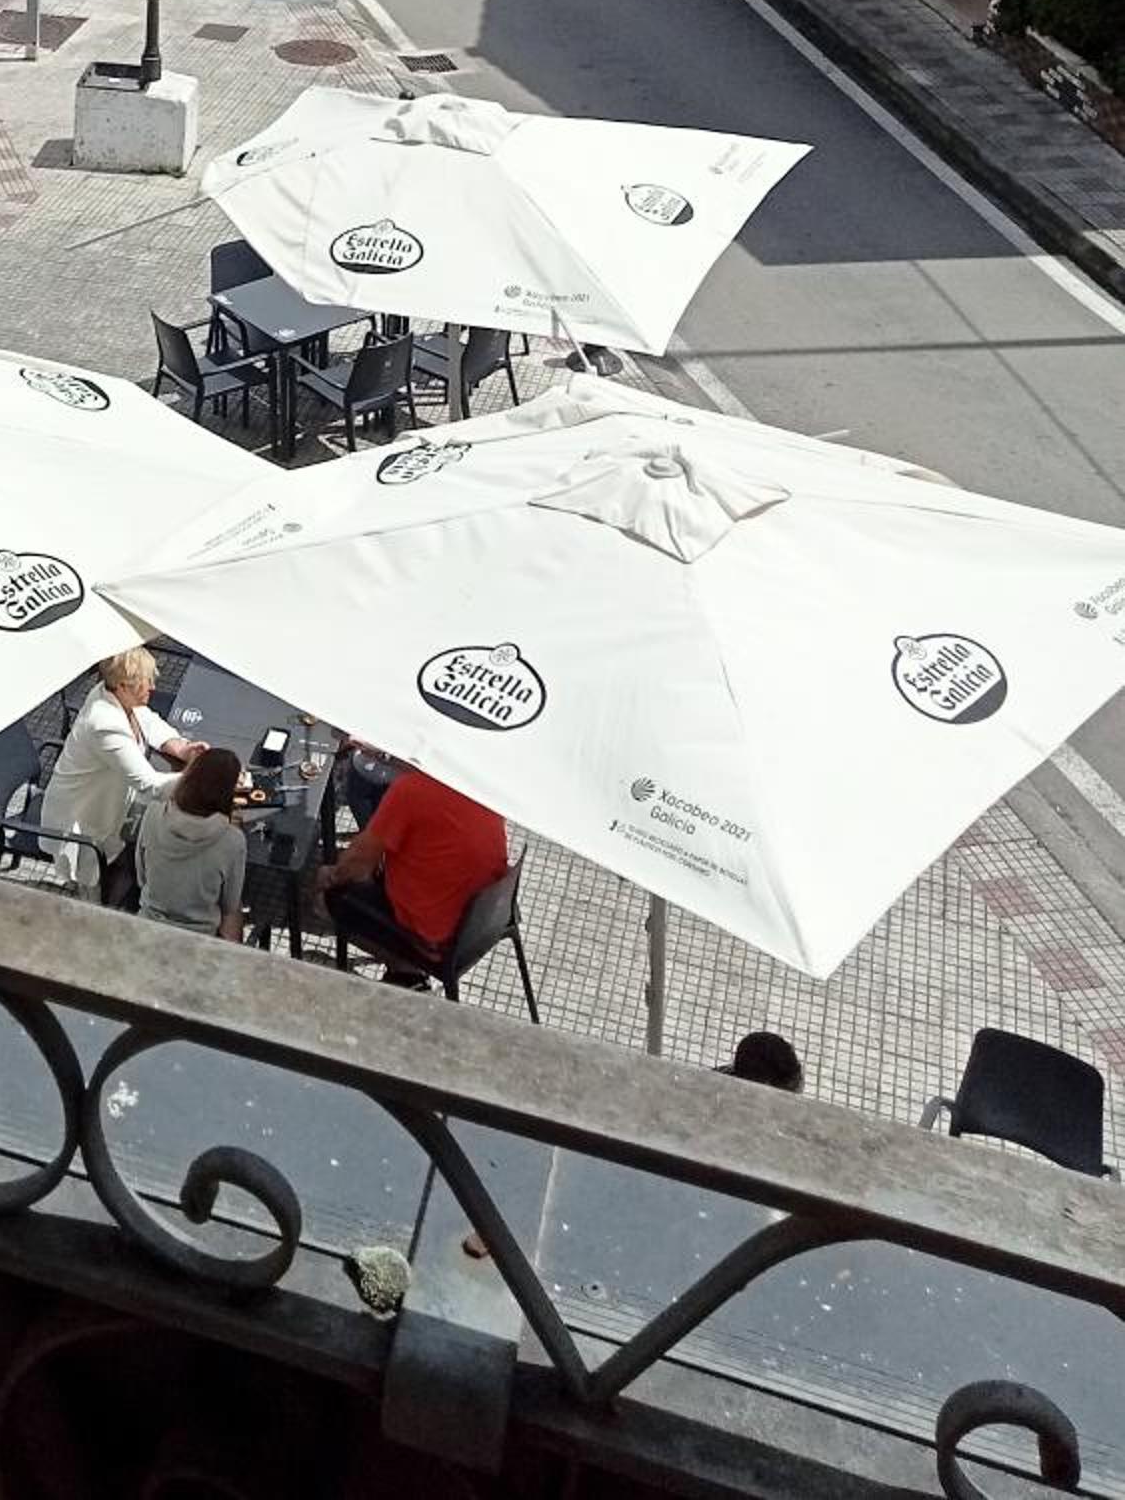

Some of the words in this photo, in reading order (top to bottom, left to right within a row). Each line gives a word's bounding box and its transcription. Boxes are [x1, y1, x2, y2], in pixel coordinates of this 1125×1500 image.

[6, 581, 74, 620] Galicia
[444, 654, 534, 703] Estrella
[903, 642, 972, 692] Estrella
[930, 663, 995, 711] Galicia
[433, 679, 513, 721] Galicia
[649, 805, 697, 835] Galicia
[658, 788, 720, 827] Xacobeo
[720, 819, 753, 842] 2021
